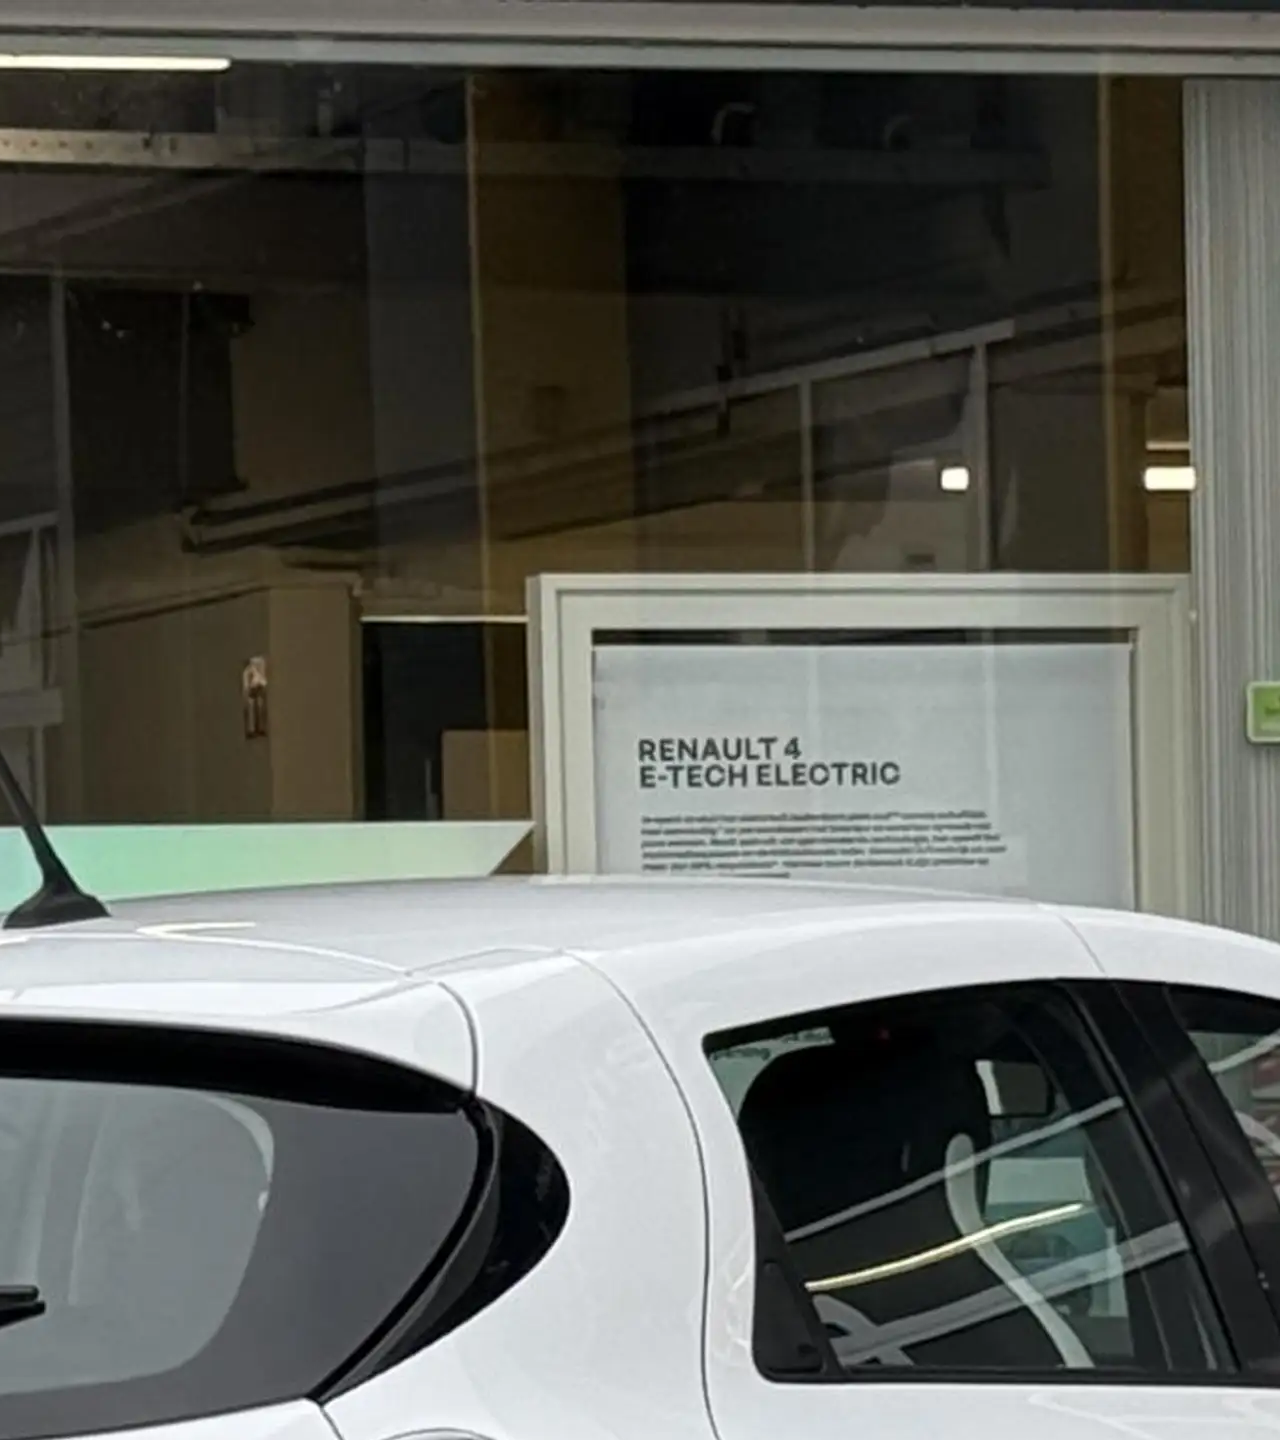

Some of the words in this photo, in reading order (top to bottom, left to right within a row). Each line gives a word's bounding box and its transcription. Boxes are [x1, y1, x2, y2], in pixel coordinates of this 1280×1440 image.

[638, 737, 778, 761] RENAULT
[783, 737, 802, 761] 4
[639, 763, 748, 789] E-TECH
[755, 761, 901, 788] ELECTRIC
